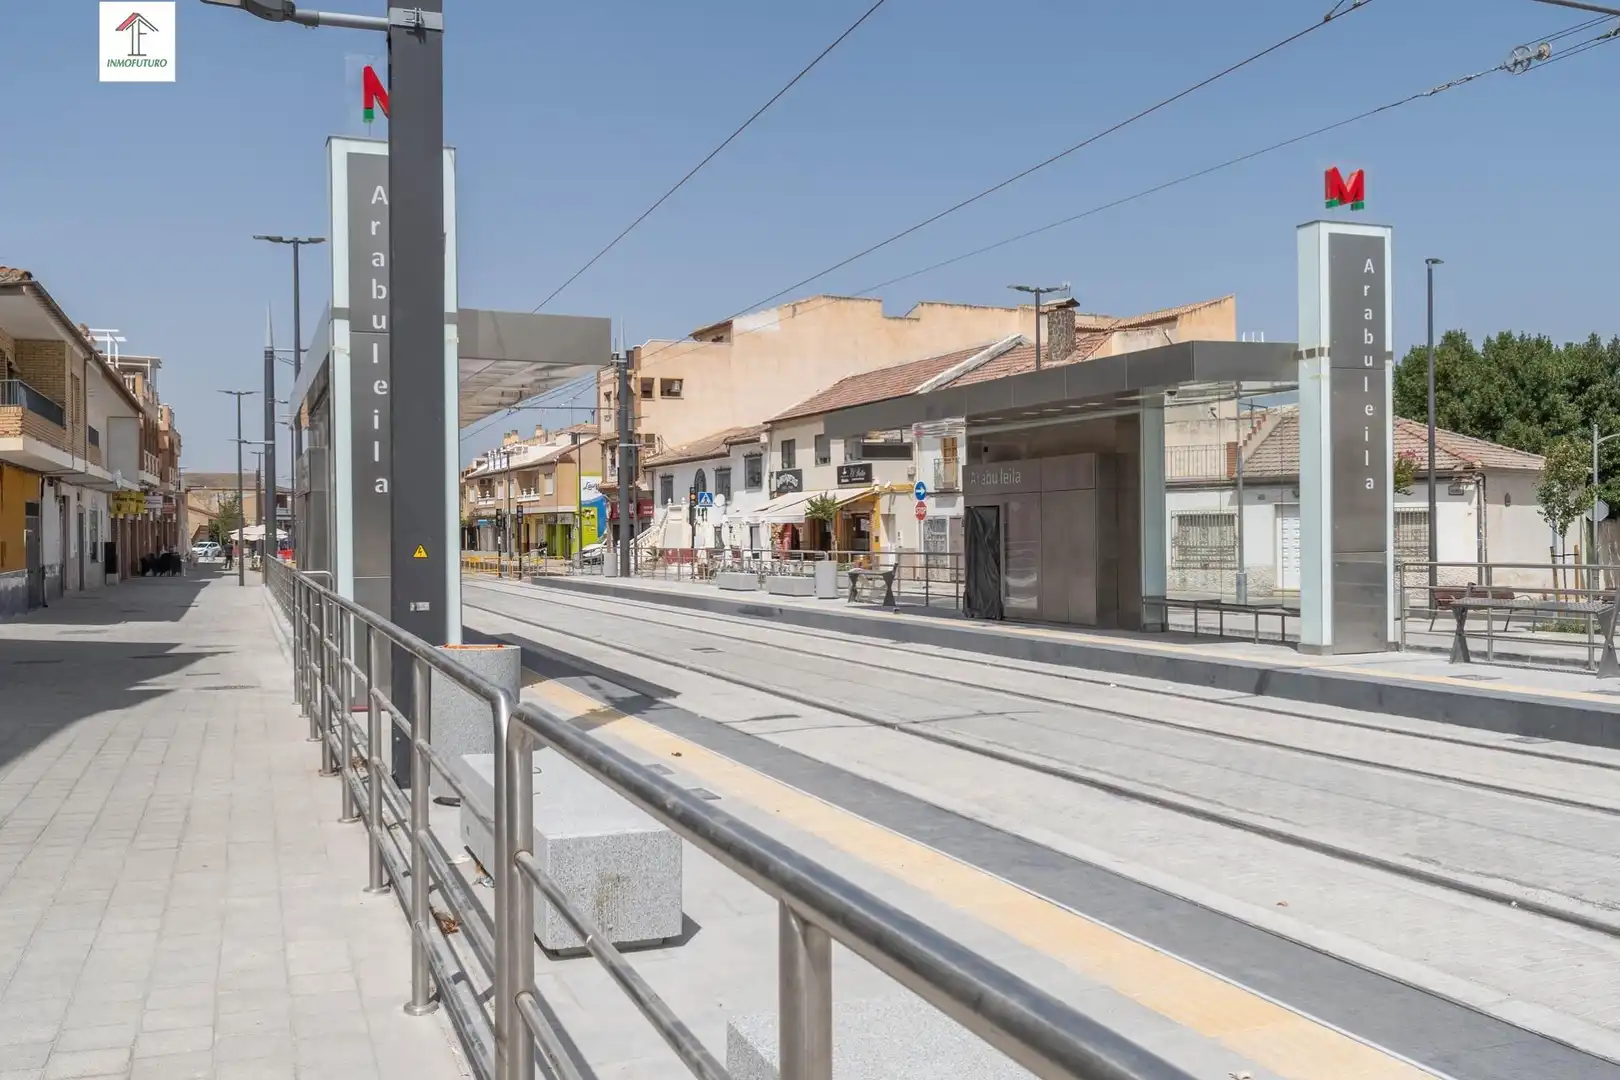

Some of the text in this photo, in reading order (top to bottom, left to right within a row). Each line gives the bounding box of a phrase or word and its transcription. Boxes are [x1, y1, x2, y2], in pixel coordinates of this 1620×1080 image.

[1325, 166, 1364, 211] M
[371, 185, 389, 493] Arabuleila
[1363, 258, 1375, 490] Arabuleila
